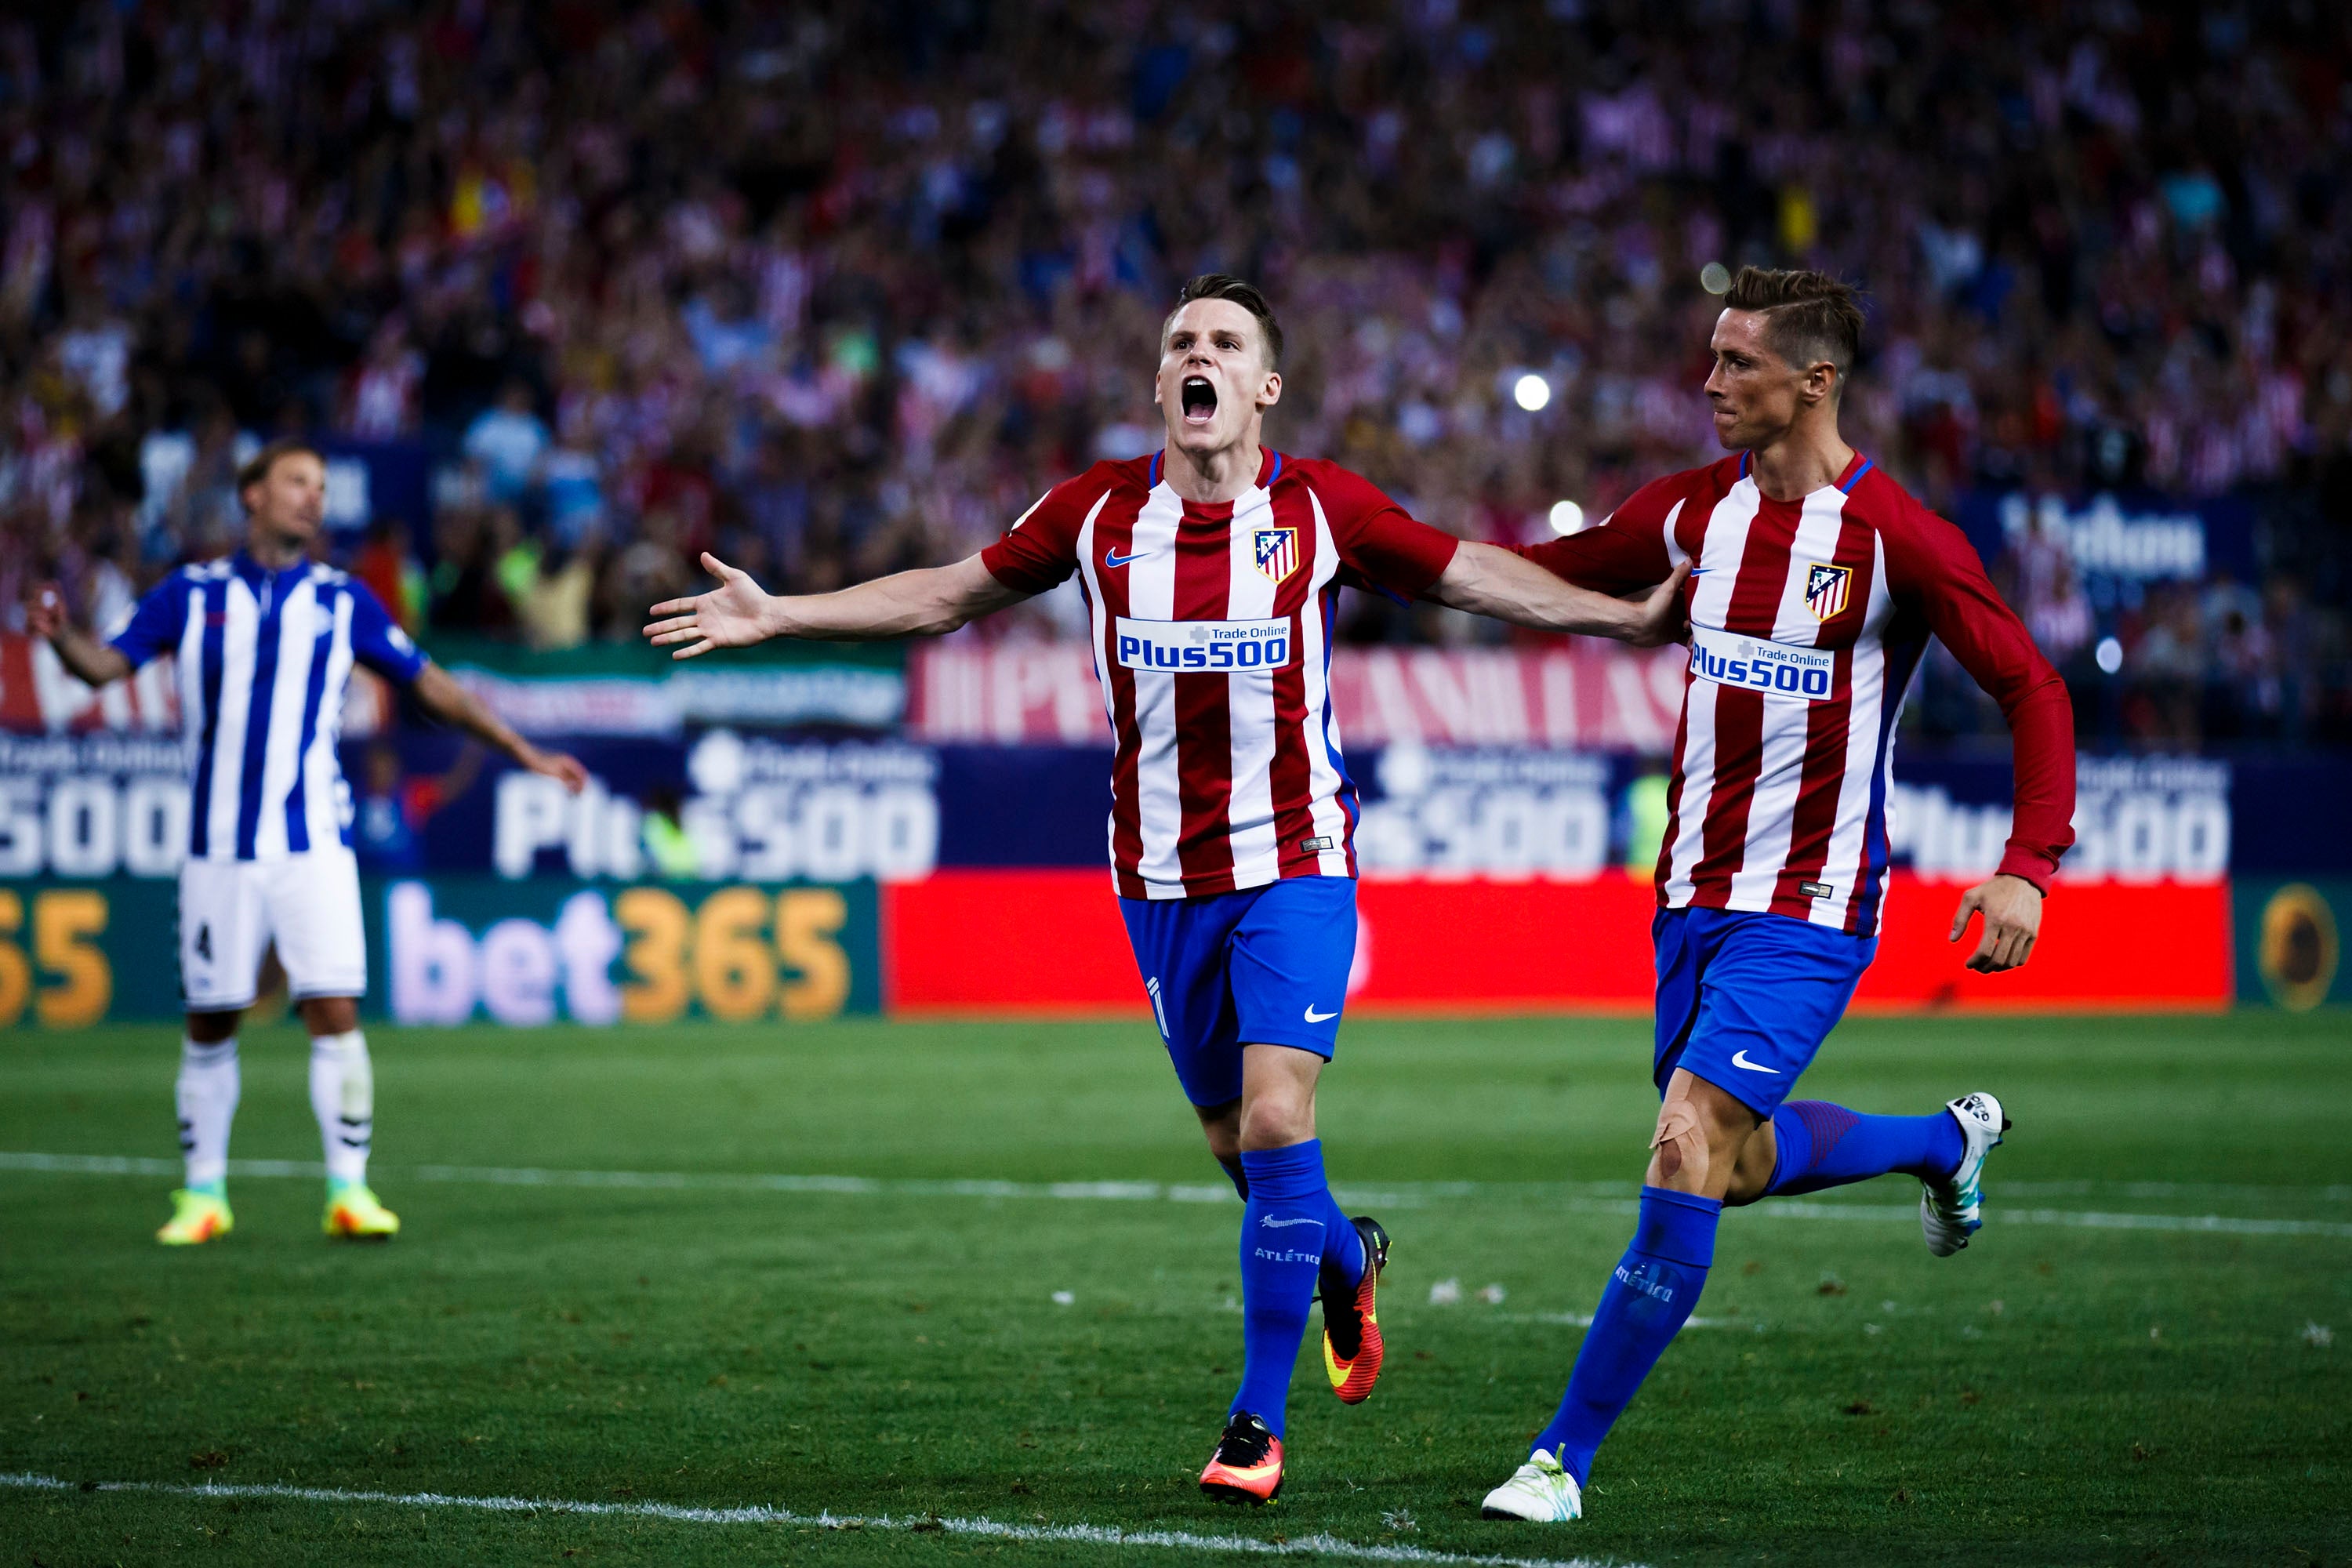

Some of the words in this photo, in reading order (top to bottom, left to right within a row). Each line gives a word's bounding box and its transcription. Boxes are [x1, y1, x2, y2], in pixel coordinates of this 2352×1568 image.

[1212, 628, 1247, 639] Trade
[1250, 626, 1287, 637] Online
[1120, 635, 1286, 667] Plus500
[1757, 646, 1788, 662] Trade
[1790, 653, 1829, 666] Online
[1692, 642, 1828, 695] Plus500
[193, 920, 212, 963] 4
[390, 883, 850, 1025] bet365
[1254, 1247, 1320, 1265] ATLÉTICO
